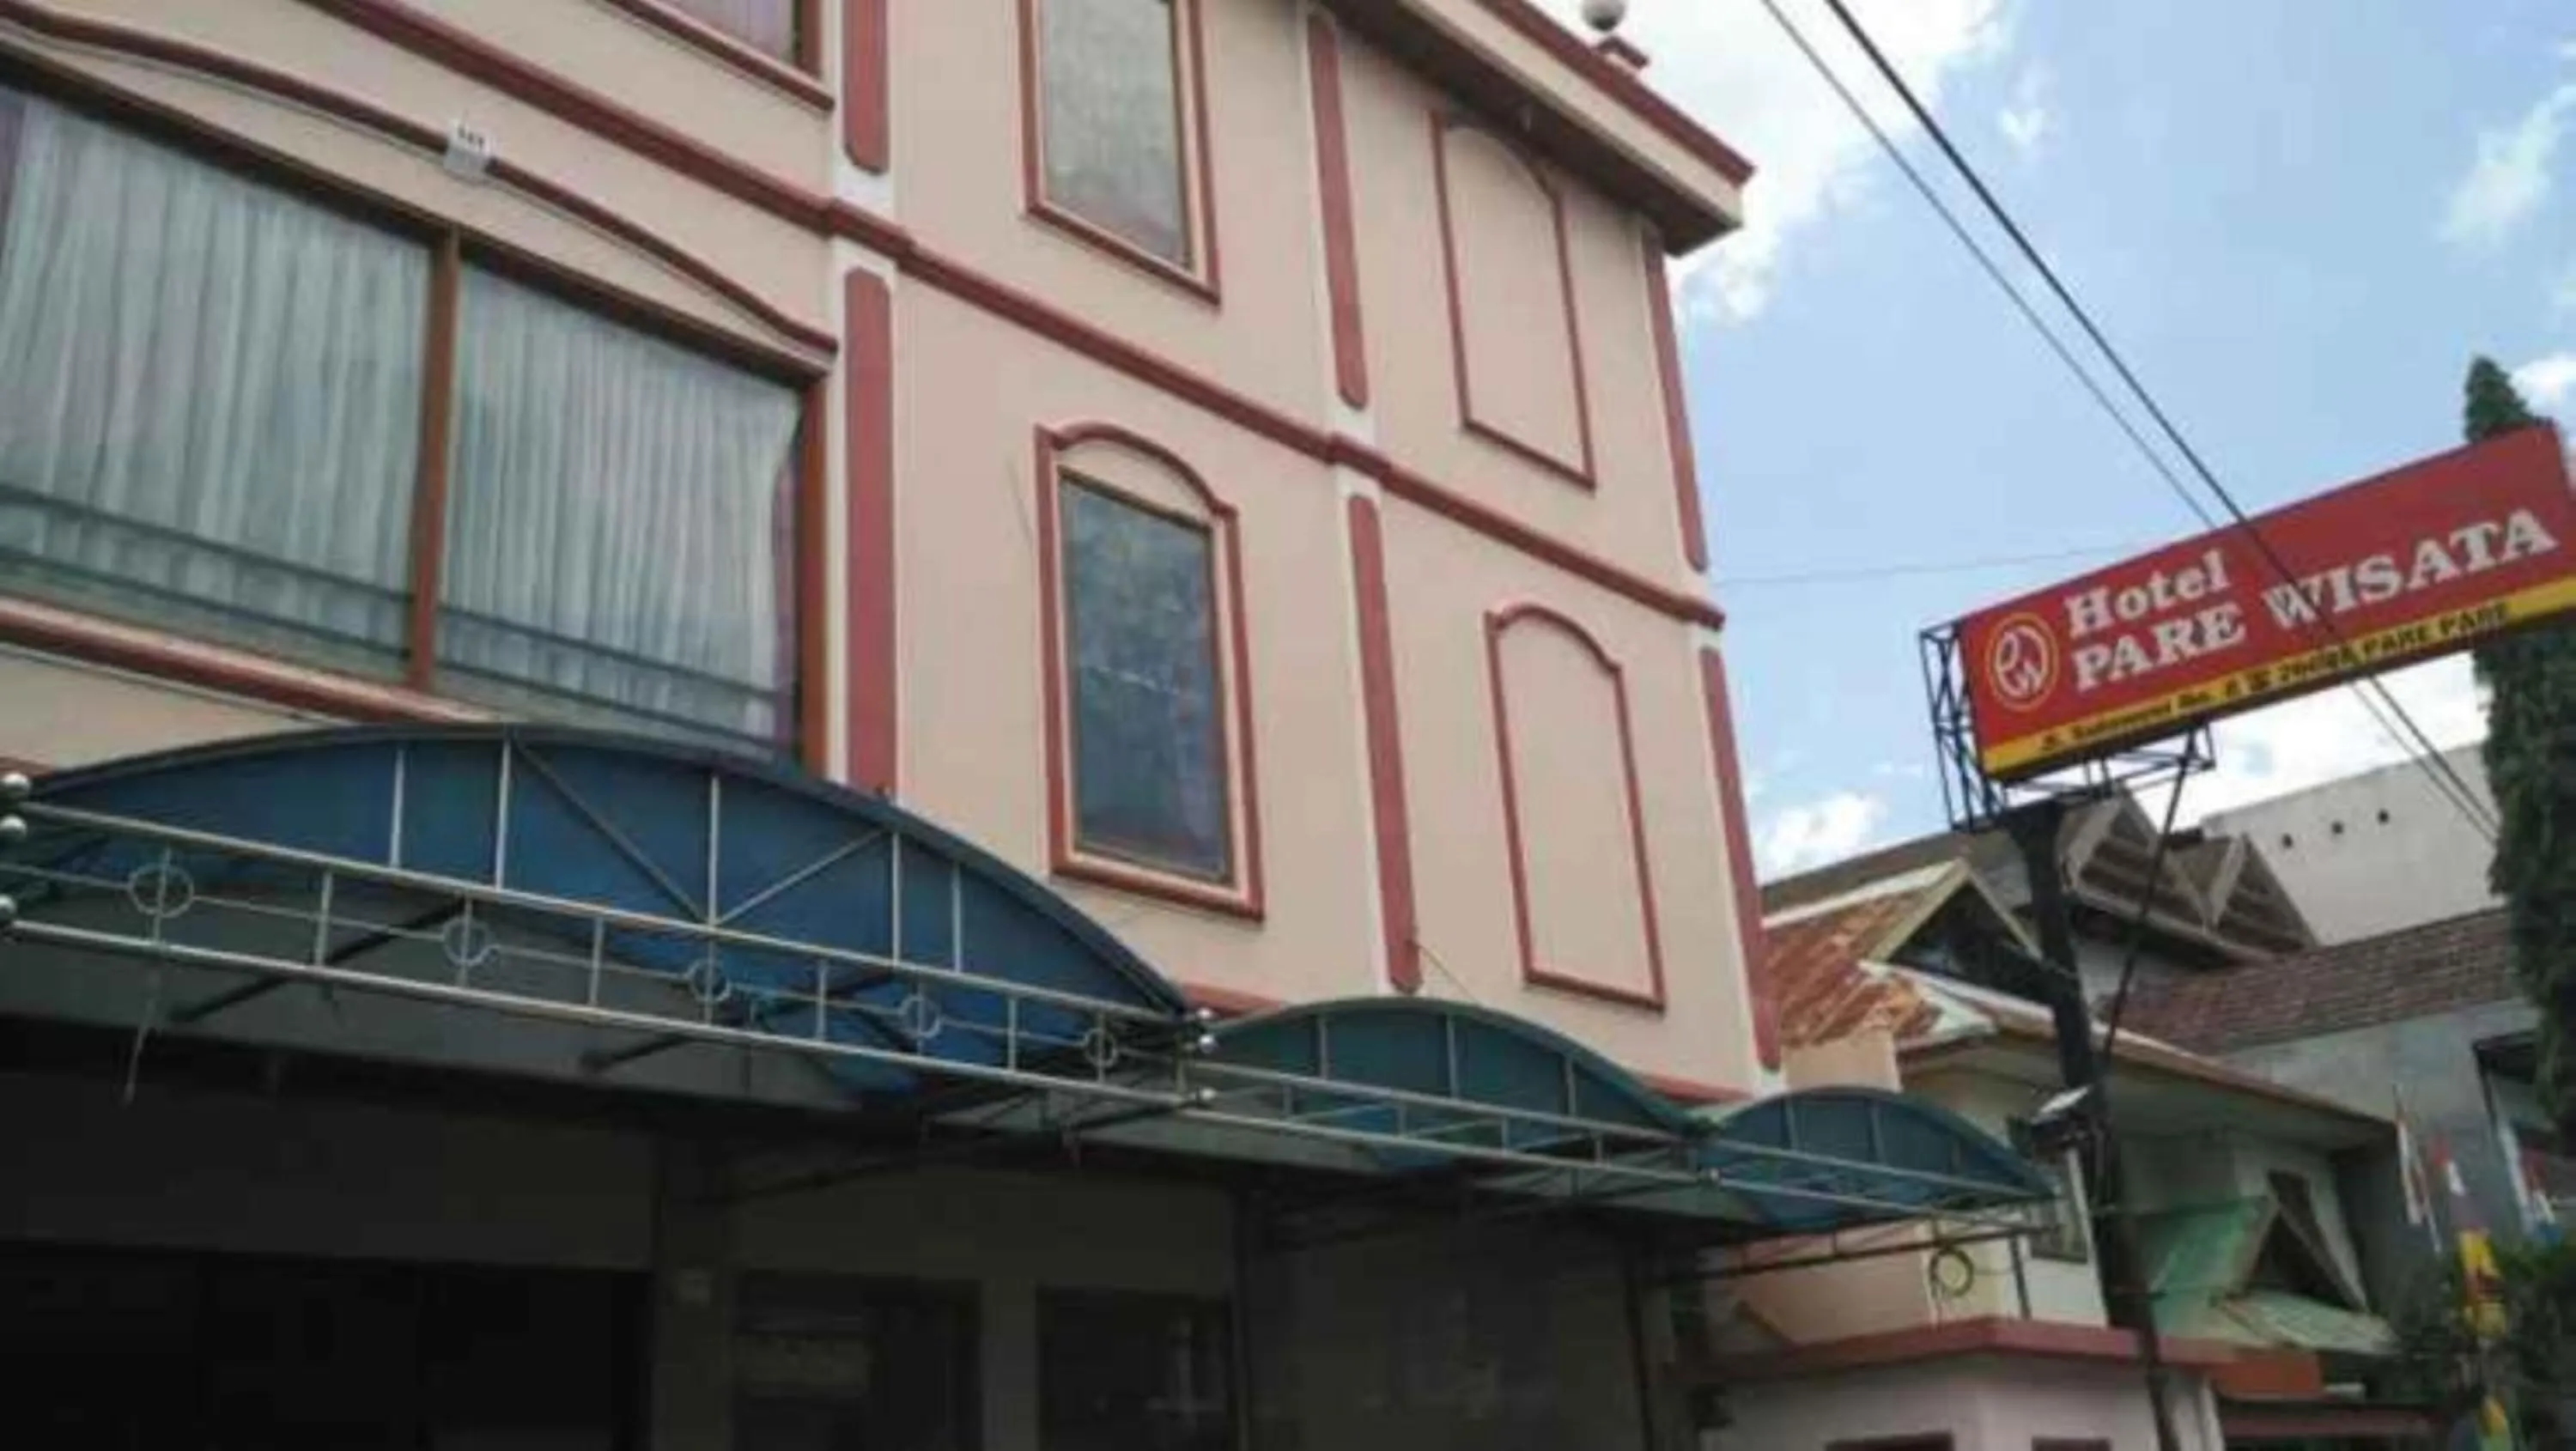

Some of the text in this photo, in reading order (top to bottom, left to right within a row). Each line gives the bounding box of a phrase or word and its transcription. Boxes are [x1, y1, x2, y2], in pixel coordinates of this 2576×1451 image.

[2063, 547, 2231, 641] Hotel
[2071, 507, 2561, 690] PARE WISATA
